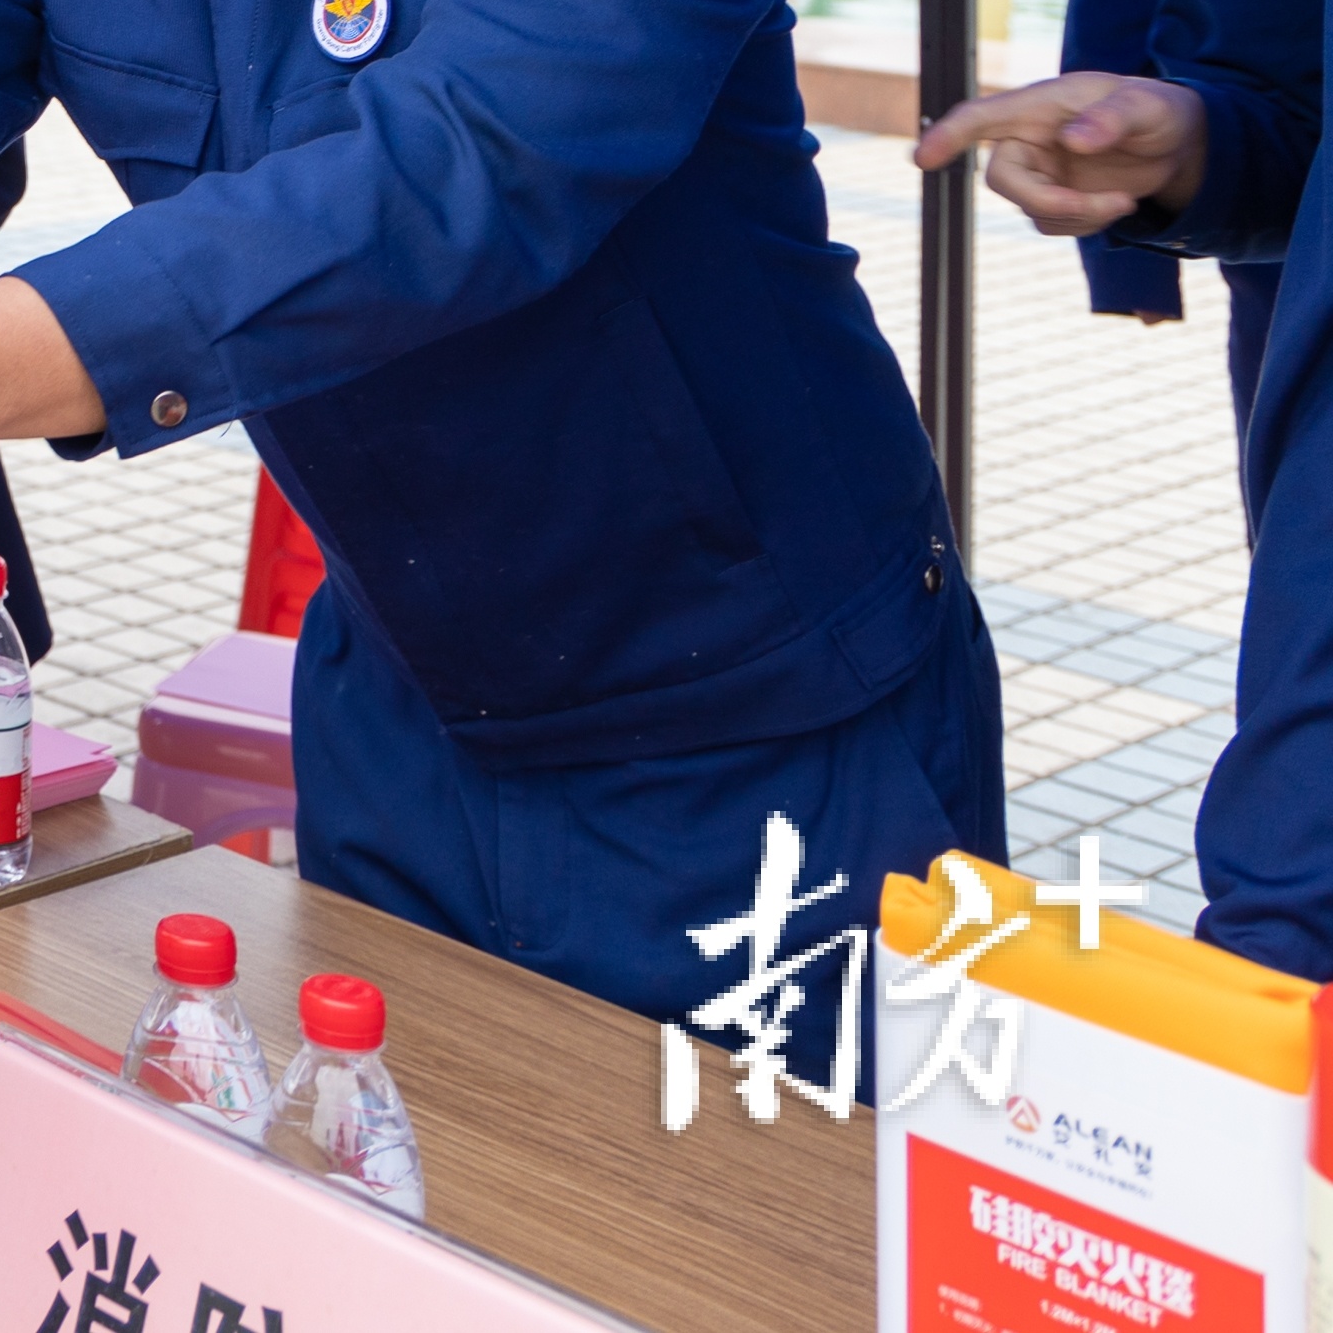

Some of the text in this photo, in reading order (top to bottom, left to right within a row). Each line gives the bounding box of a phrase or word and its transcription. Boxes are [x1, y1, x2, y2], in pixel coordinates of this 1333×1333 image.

[1053, 1112, 1153, 1162] ALEAN
[968, 1184, 1196, 1319] 硅胶灭火毯
[997, 1242, 1047, 1282] FIRE
[1054, 1265, 1165, 1329] BLANKET
